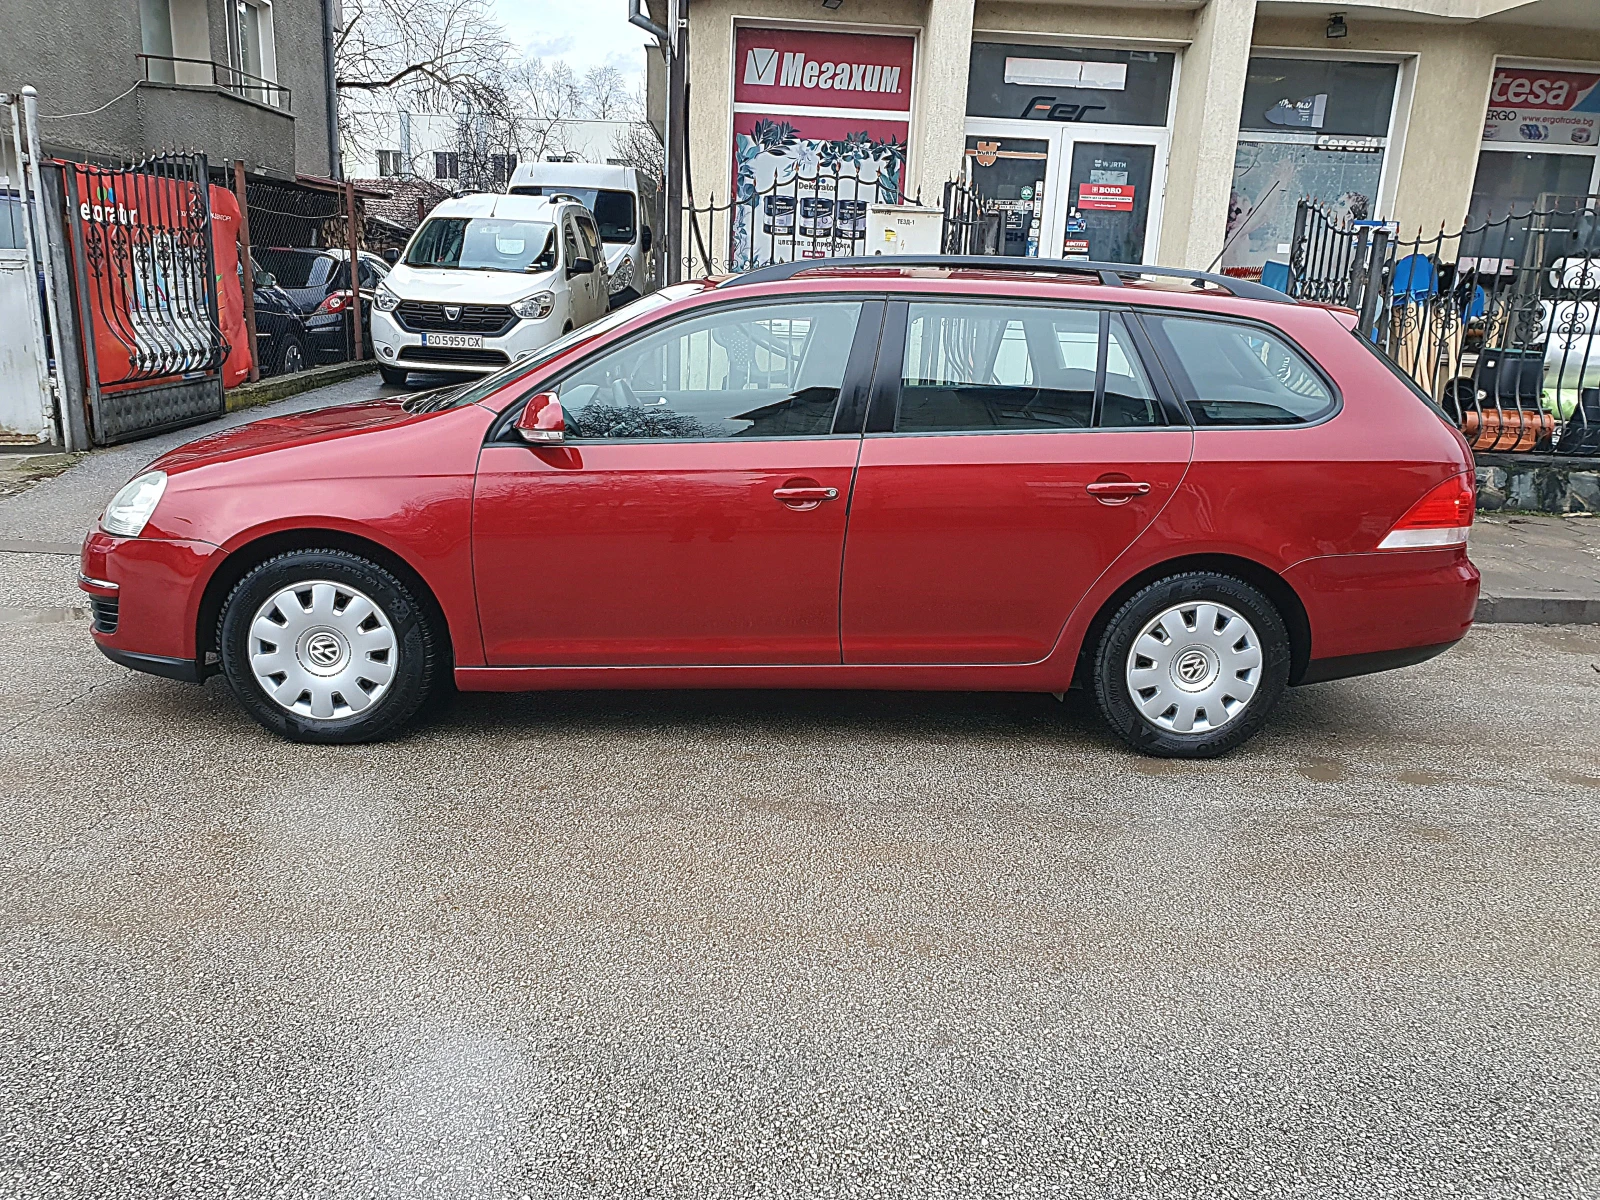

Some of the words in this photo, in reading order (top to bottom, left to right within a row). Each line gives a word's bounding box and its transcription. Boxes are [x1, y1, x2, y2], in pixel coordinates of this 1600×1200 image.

[780, 52, 900, 94] Мегахим
[1491, 72, 1570, 105] tesa
[1486, 109, 1517, 121] ERGO
[1522, 114, 1594, 127] www.ergotrade.bg
[1099, 186, 1122, 194] BORO
[66, 195, 138, 226] ekoratr
[442, 336, 466, 346] 5959
